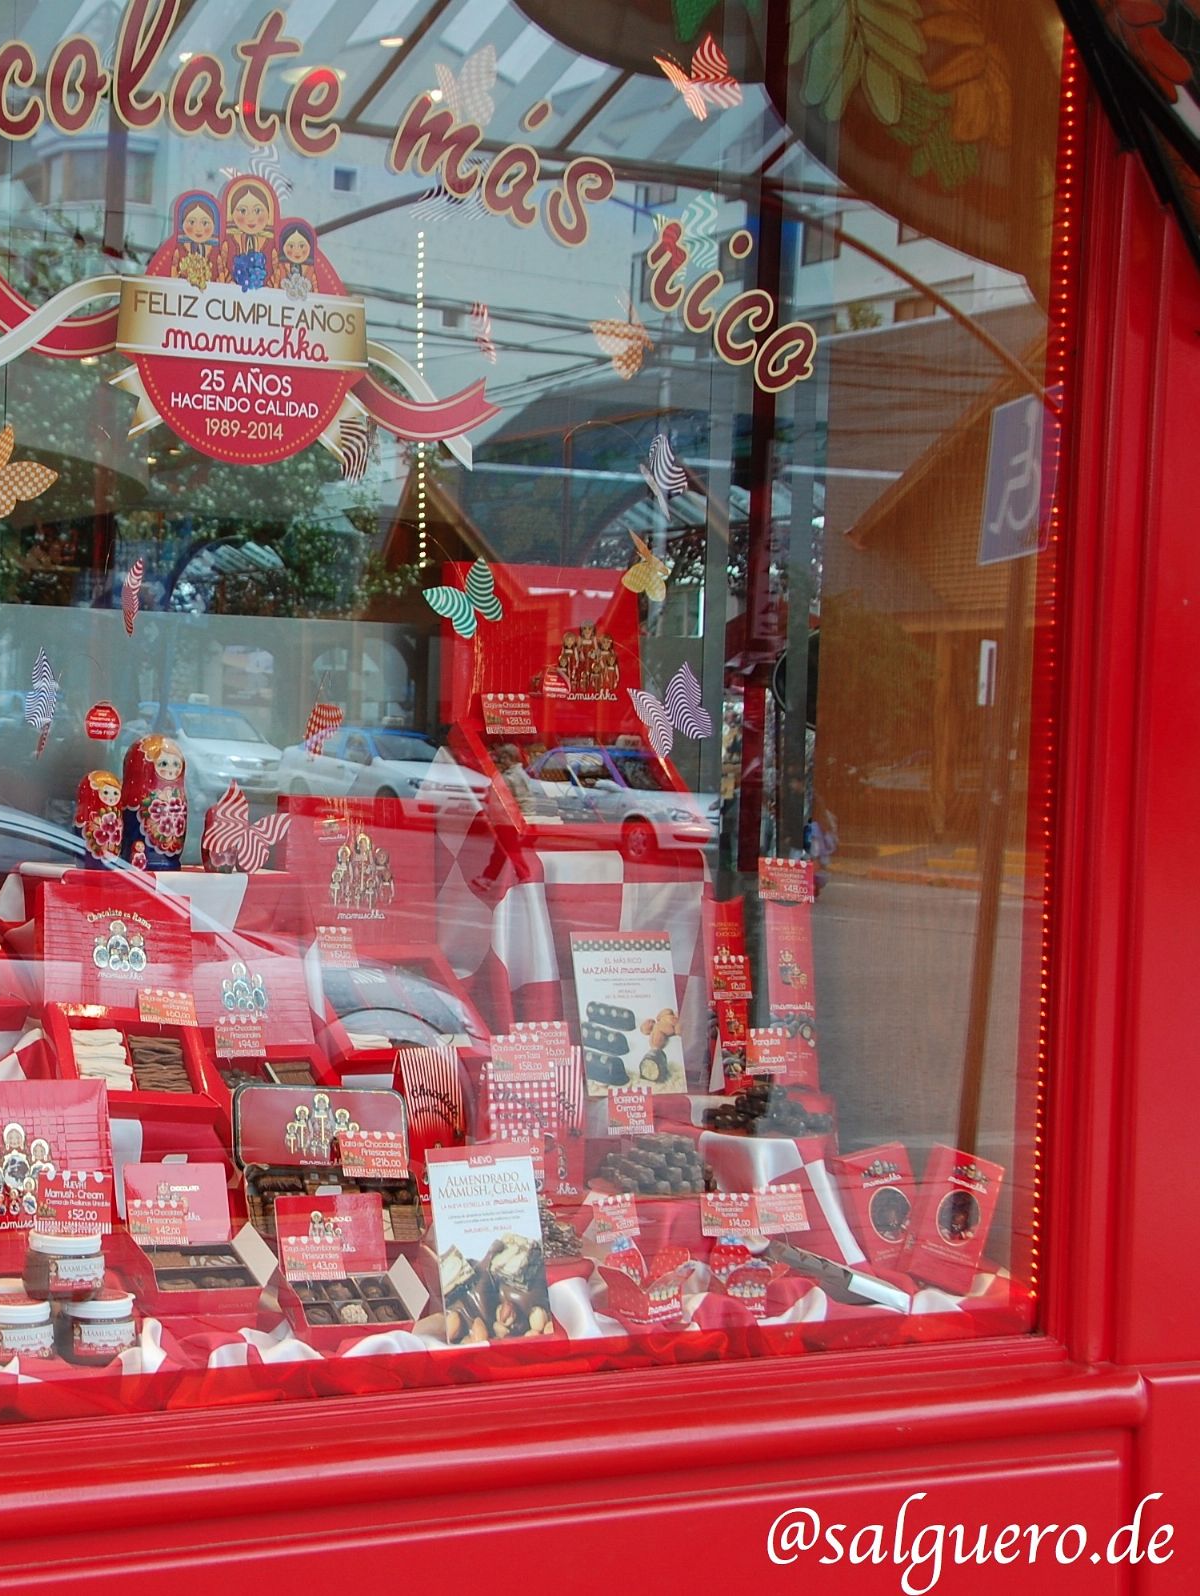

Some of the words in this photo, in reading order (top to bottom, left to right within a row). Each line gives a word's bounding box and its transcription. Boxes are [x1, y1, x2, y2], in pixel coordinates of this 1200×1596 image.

[390, 91, 615, 247] más
[647, 218, 818, 393] rico
[133, 289, 197, 317] FELIZ
[206, 297, 356, 333] CUMPLEAÑOS
[162, 326, 329, 364] mamuschka
[200, 369, 224, 392] 25
[230, 367, 293, 398] AÑOS
[171, 392, 251, 413] HACIENDO
[255, 398, 319, 420] CALIDAD
[205, 417, 284, 441] 1989-2014
[337, 909, 385, 920] mamuschka
[470, 1156, 492, 1165] NUEVO
[447, 1171, 519, 1187] ALMENDRADO
[493, 1182, 530, 1196] CREAM
[45, 1189, 74, 1199] Mamush
[77, 1190, 105, 1200] Cream
